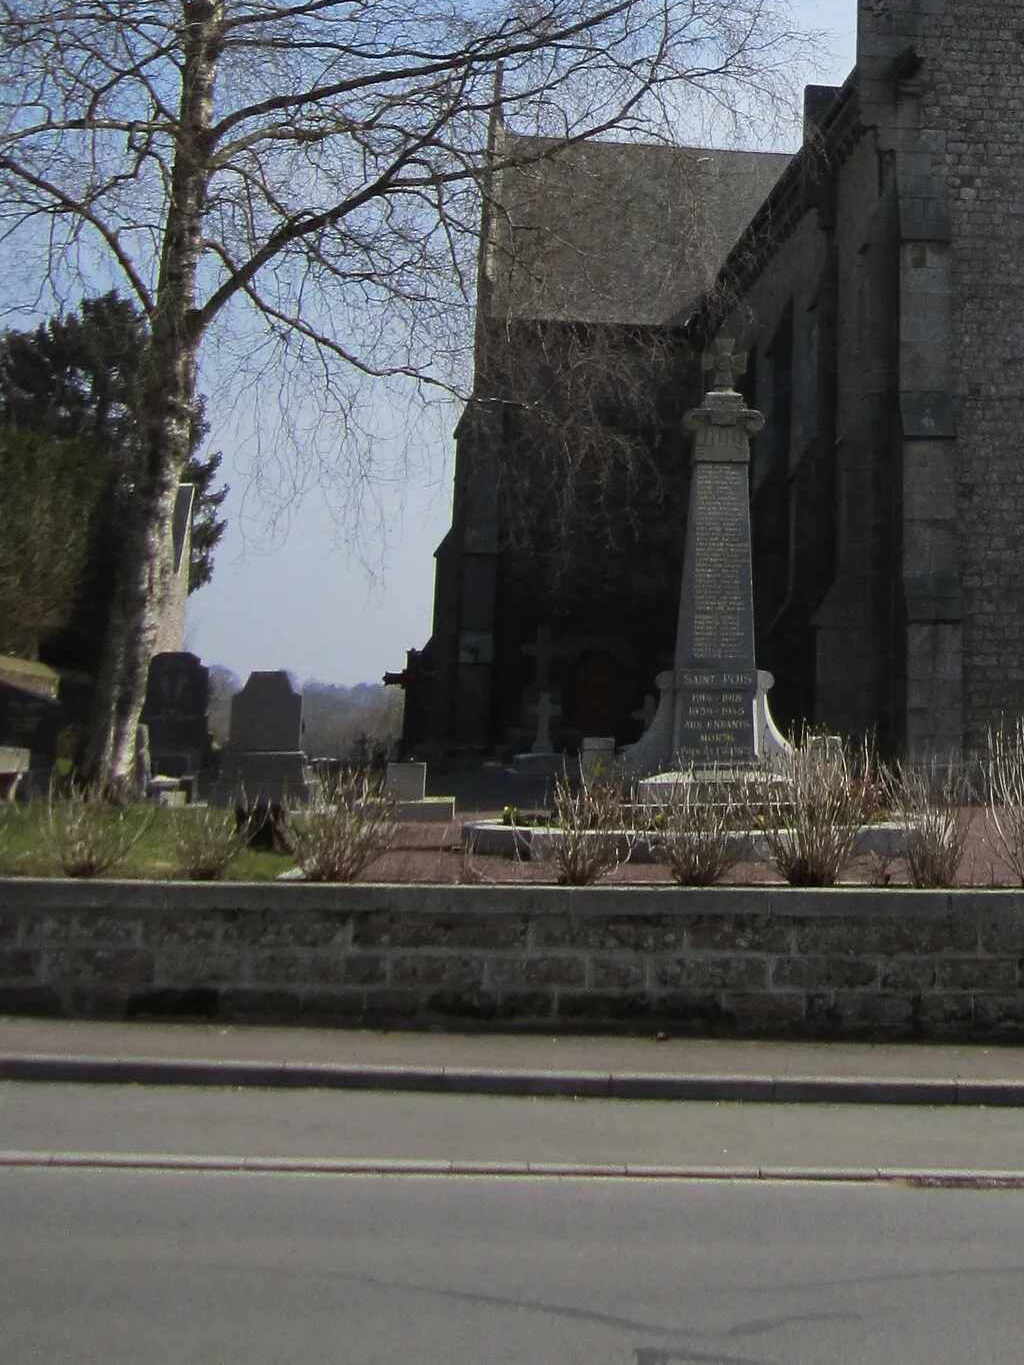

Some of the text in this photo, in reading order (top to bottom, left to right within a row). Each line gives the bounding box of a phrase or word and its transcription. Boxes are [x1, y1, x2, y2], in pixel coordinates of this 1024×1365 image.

[684, 673, 752, 685] SAINT POIS
[684, 720, 751, 729] AUX ENFANTS
[700, 733, 734, 742] MORTS
